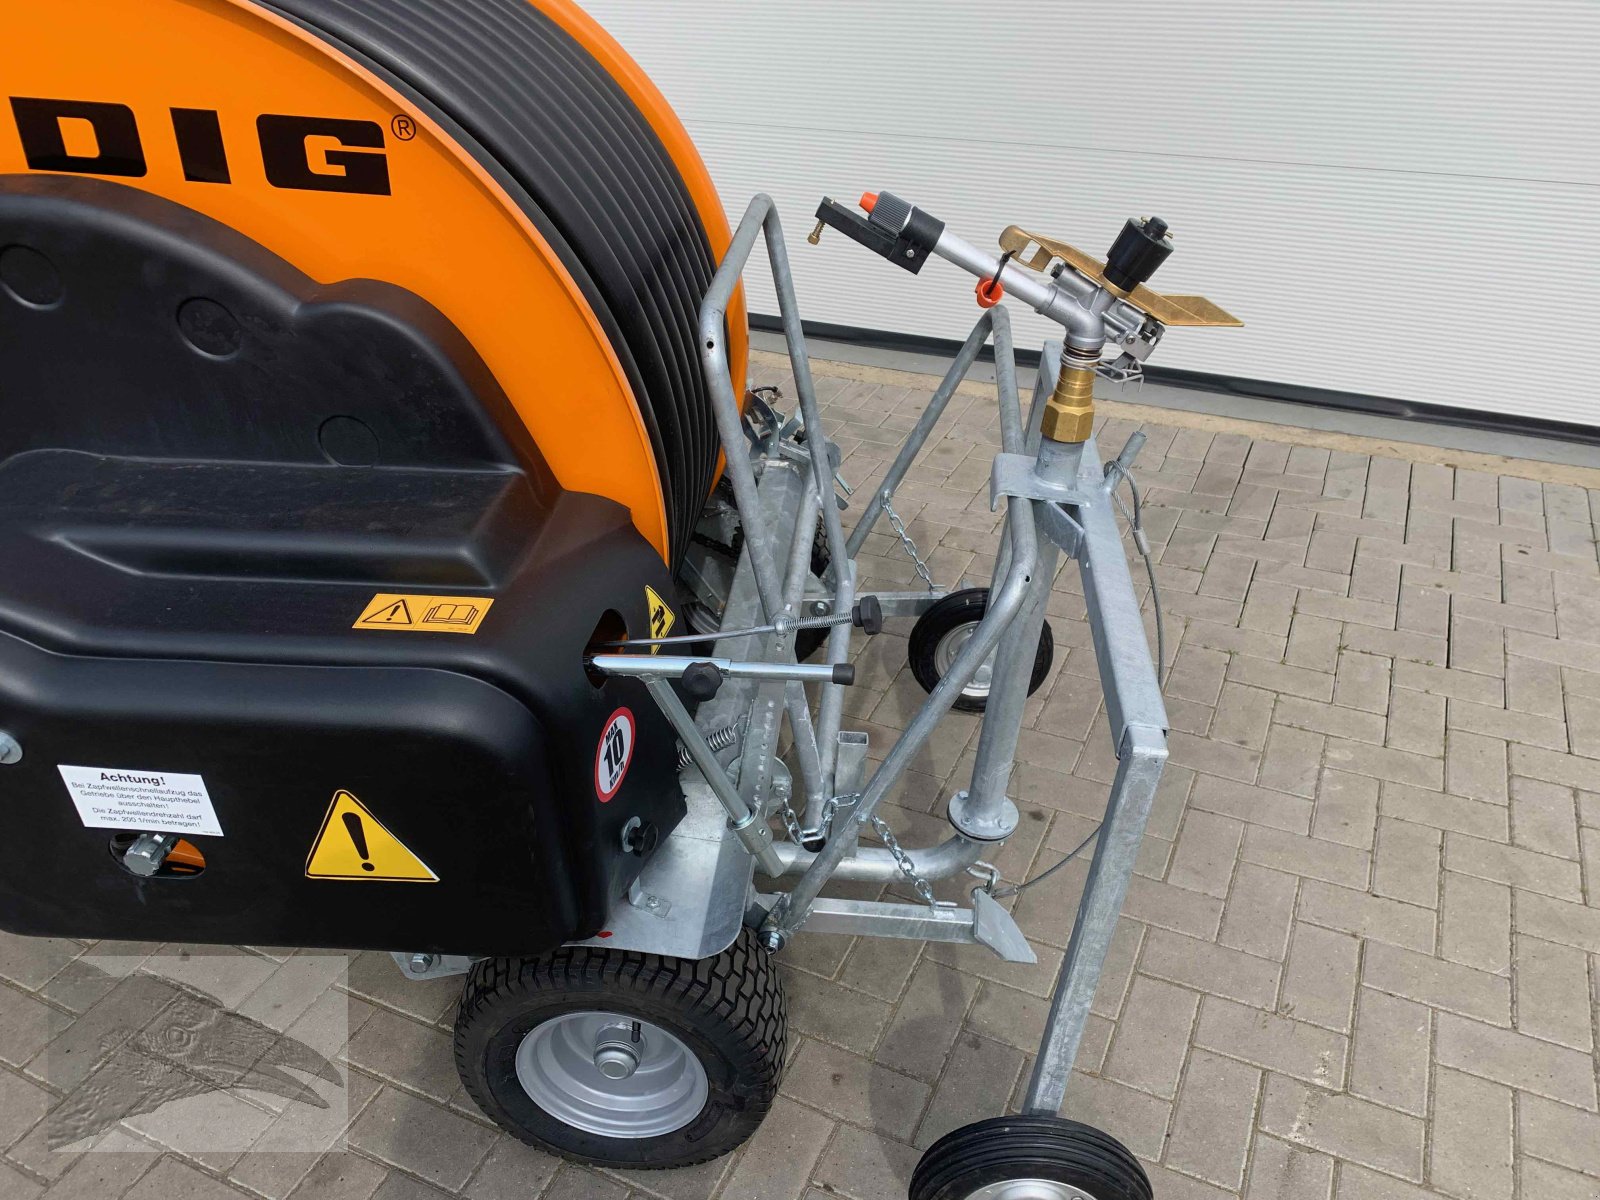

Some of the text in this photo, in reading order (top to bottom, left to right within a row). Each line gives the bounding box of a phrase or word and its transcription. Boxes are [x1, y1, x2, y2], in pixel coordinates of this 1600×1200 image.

[605, 720, 618, 746] MAX
[603, 728, 625, 778] 10
[100, 772, 166, 786] Achtung!
[71, 781, 85, 789] Bei
[187, 789, 203, 797] das
[80, 790, 115, 798] Getriebe
[153, 795, 201, 804] Haupthebel
[118, 801, 169, 809] ausschalten!
[108, 808, 185, 819] Zapfwellendrehzahl
[186, 812, 203, 820] darf
[161, 820, 201, 828] betragen!
